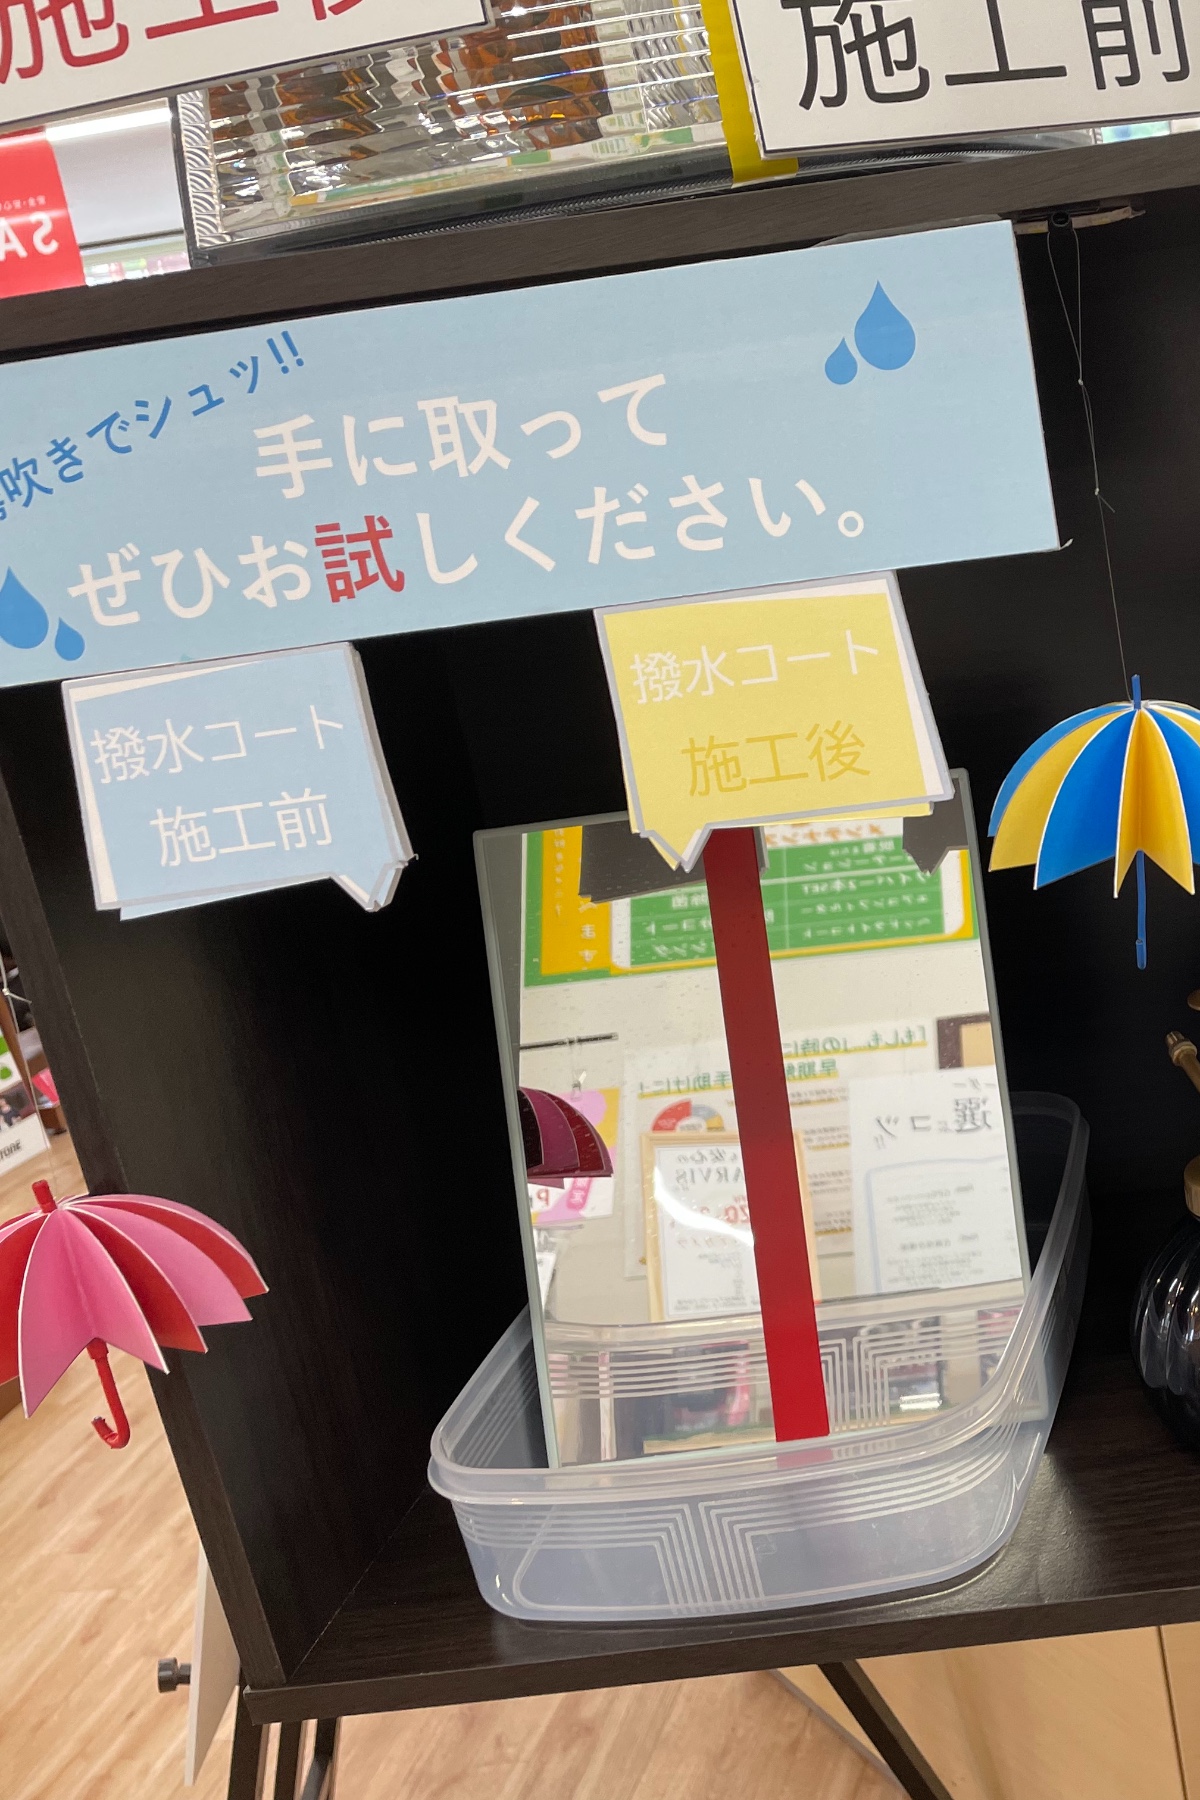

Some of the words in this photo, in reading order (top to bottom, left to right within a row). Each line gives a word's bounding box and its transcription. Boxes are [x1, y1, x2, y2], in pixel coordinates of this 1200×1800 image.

[0, 330, 306, 522] 吹きでシュッ!!
[252, 373, 668, 499] 手に取って
[68, 473, 866, 629] ぜひお試しください。
[630, 629, 879, 704] 撥水コート
[90, 704, 344, 784] 撥水コート
[681, 719, 871, 797] 施工後
[149, 787, 333, 867] 施工前
